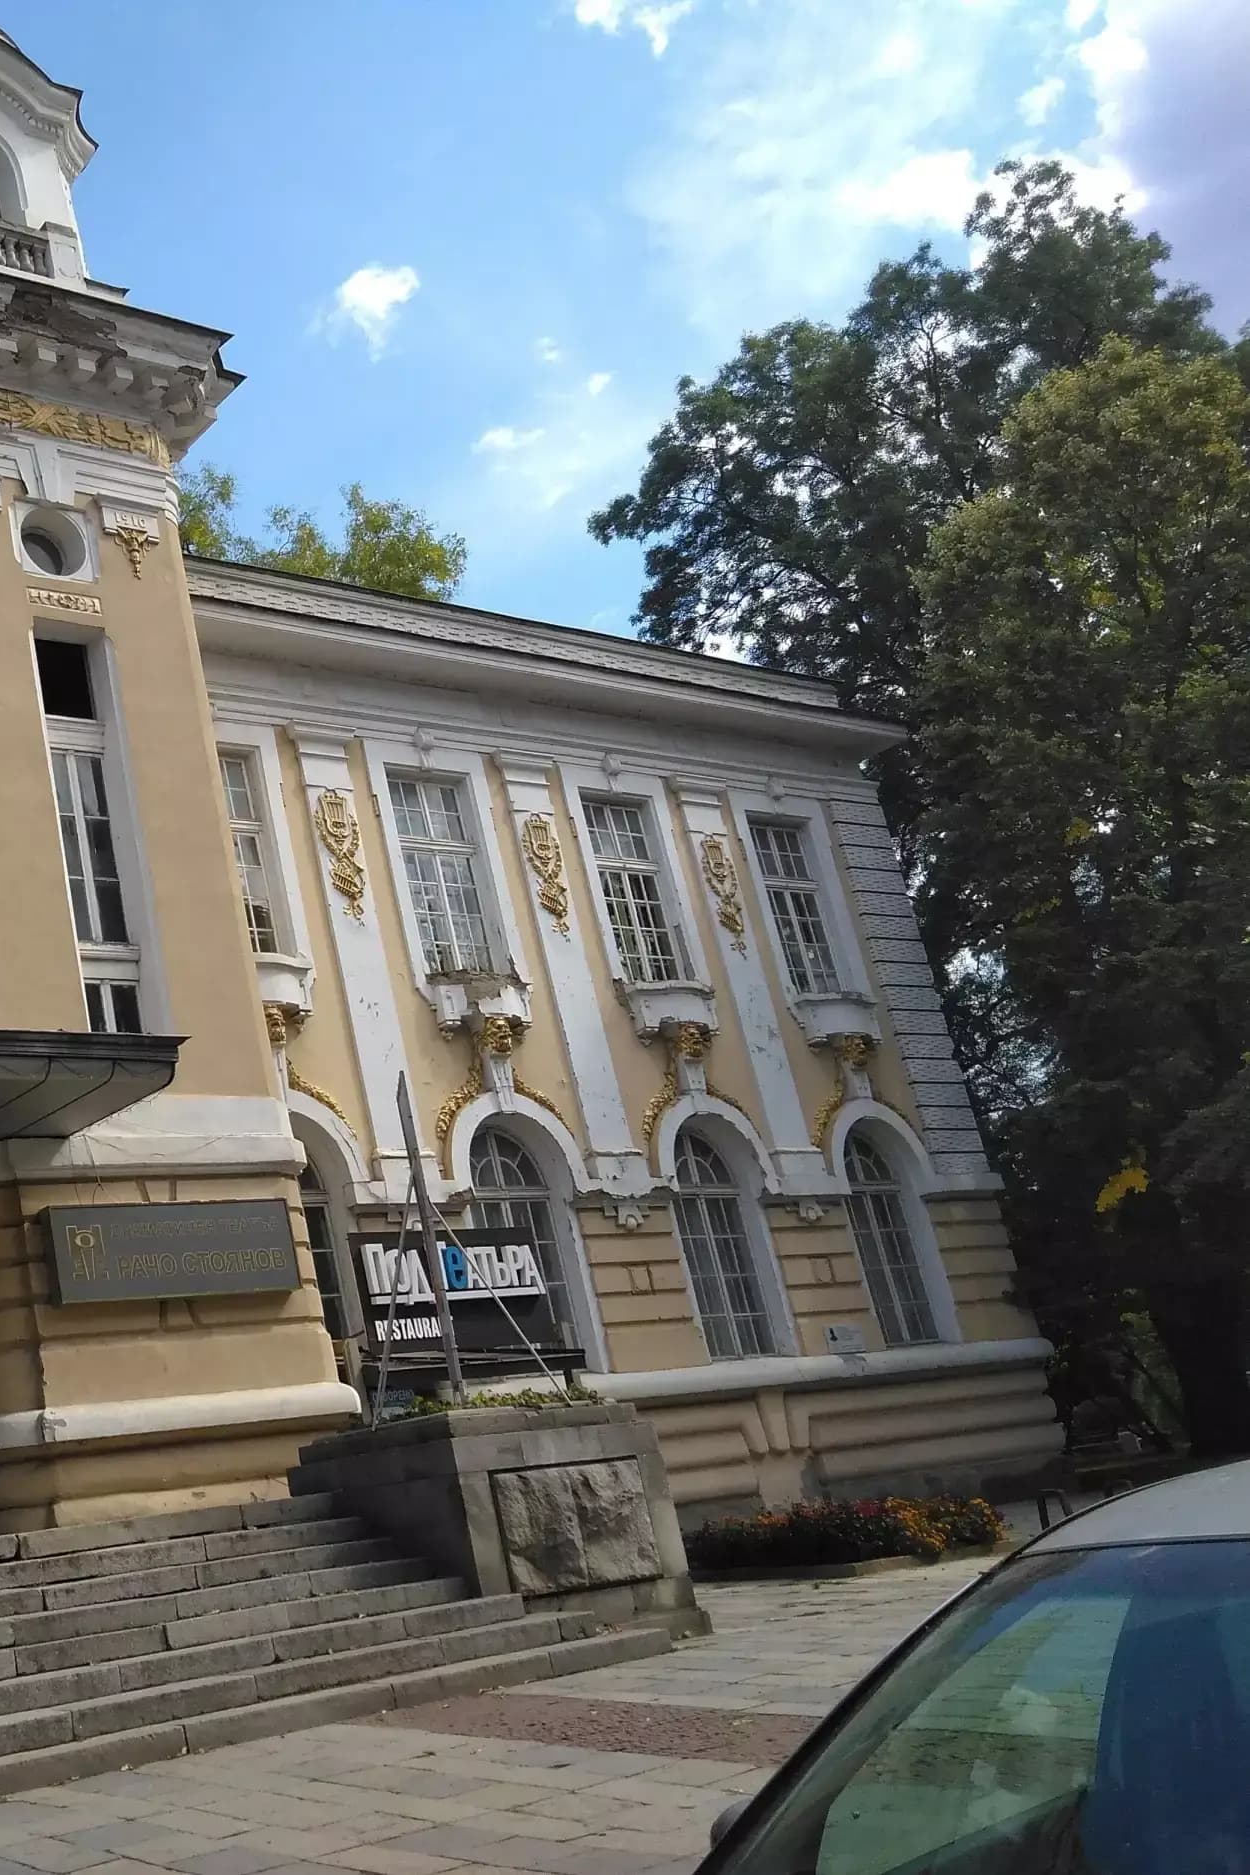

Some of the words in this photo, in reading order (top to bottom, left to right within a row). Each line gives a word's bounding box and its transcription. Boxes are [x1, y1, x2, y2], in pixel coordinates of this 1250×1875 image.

[115, 511, 147, 529] 1910
[117, 1251, 178, 1281] РАЧО
[182, 1247, 287, 1276] СТОЯНОВ
[374, 1315, 454, 1342] RSTAURA
